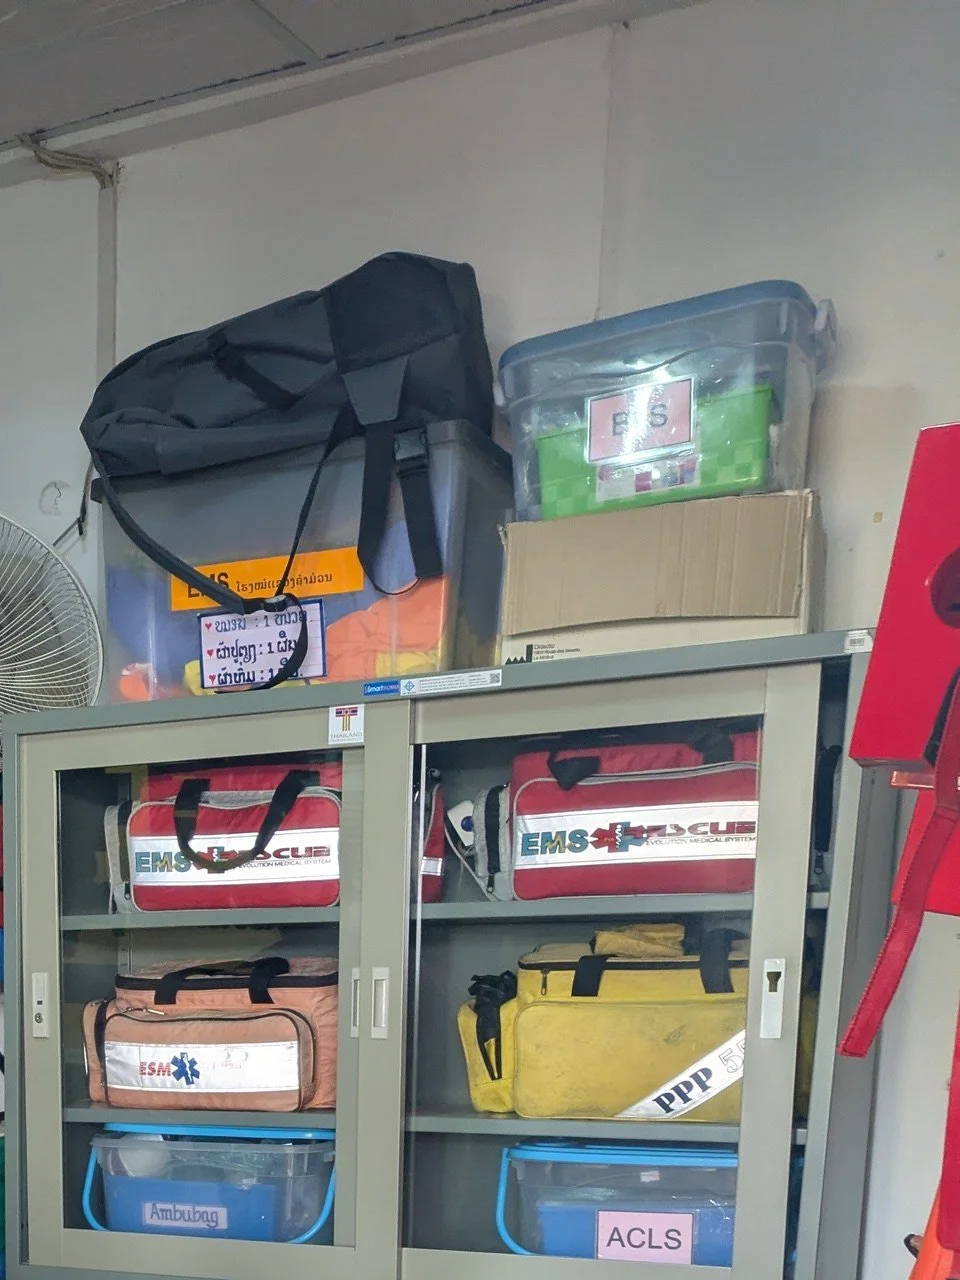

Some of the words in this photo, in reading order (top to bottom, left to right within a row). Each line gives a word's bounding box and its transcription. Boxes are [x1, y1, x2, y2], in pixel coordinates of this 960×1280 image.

[612, 403, 668, 436] BS
[521, 829, 590, 856] EMS
[135, 850, 192, 873] EMS
[138, 1061, 172, 1078] ESM
[652, 1066, 714, 1114] PPP
[149, 1203, 221, 1228] Ambubag
[606, 1227, 683, 1250] ACLS
